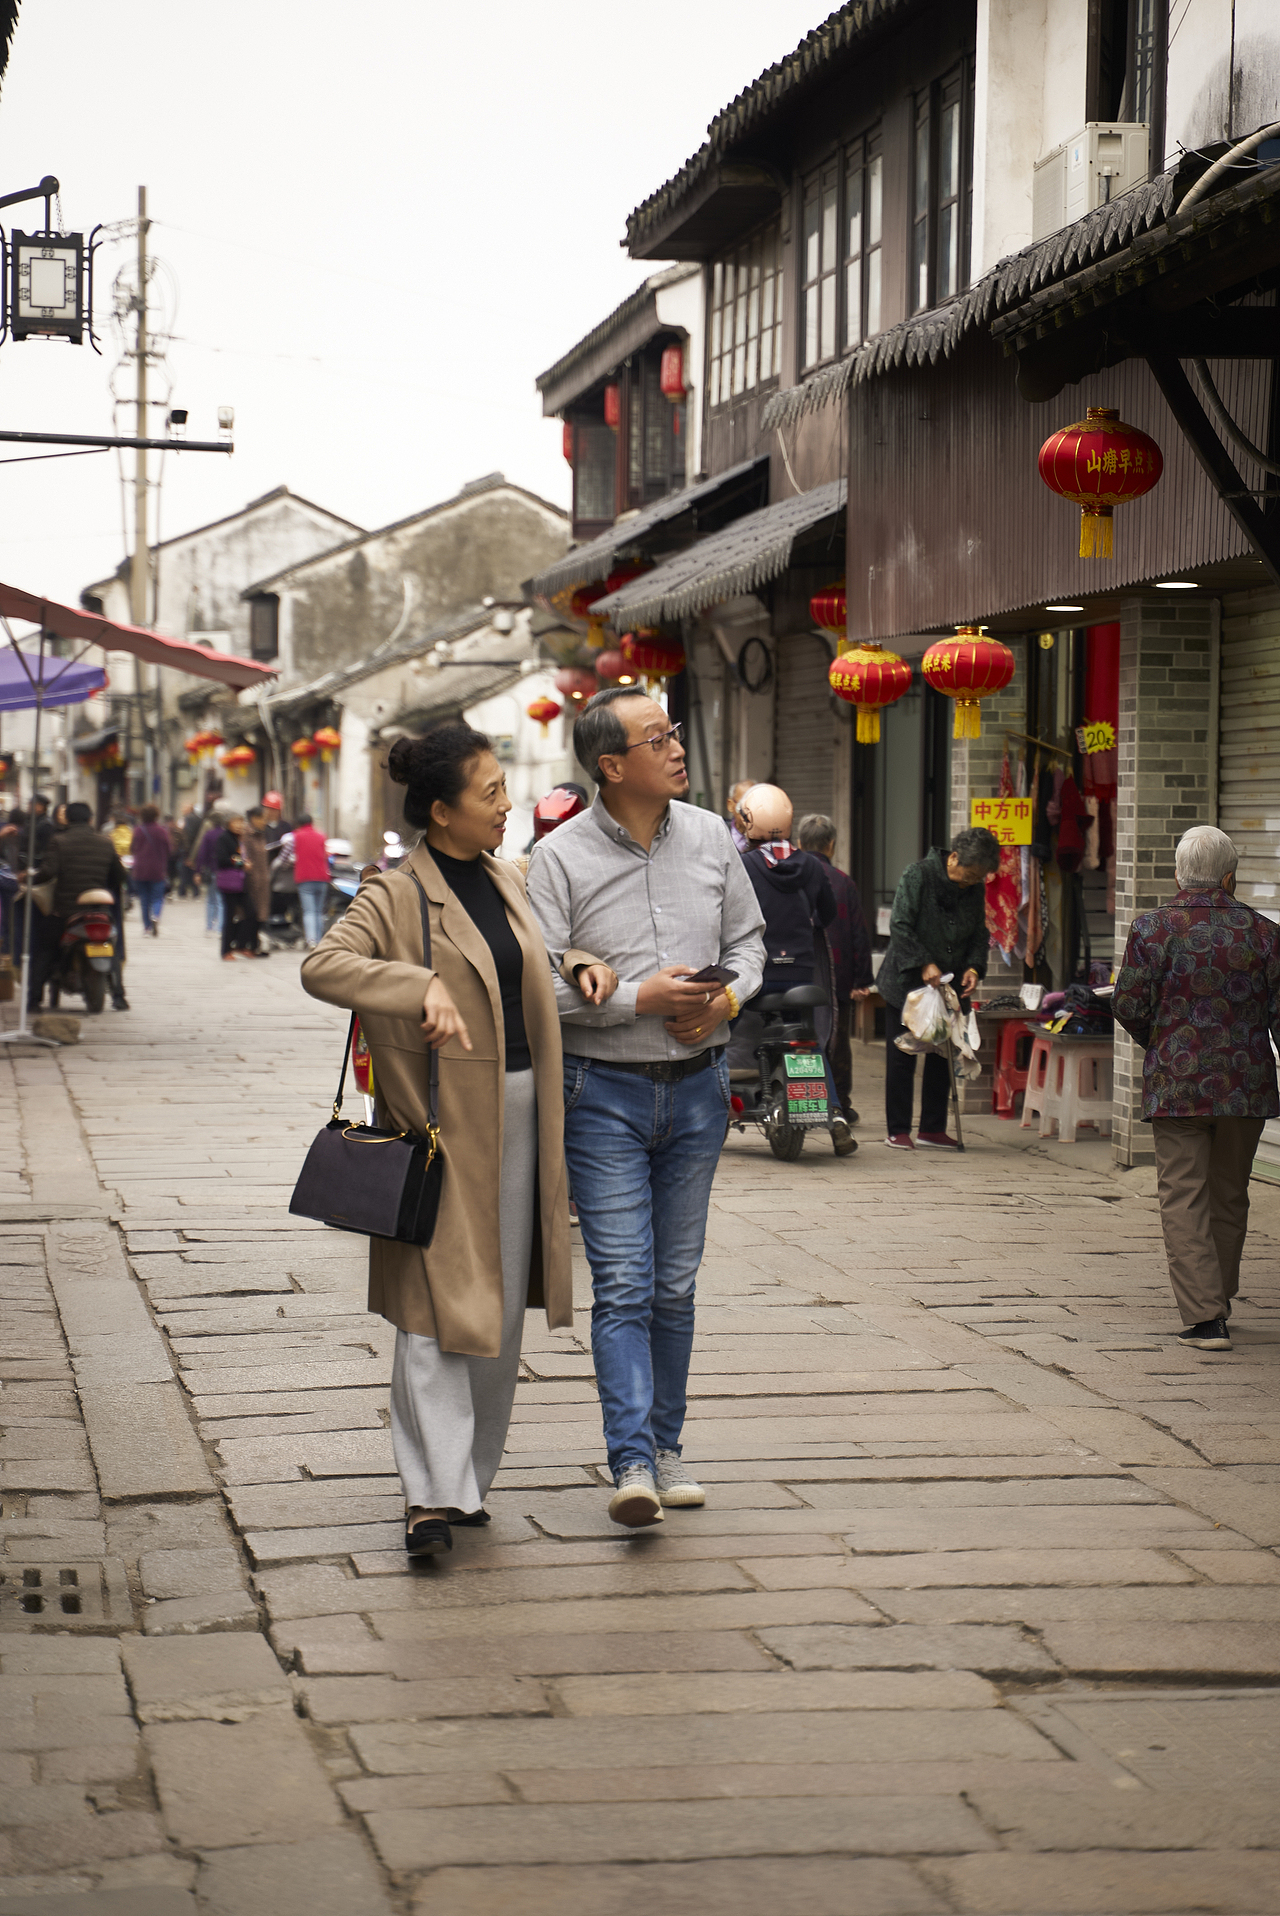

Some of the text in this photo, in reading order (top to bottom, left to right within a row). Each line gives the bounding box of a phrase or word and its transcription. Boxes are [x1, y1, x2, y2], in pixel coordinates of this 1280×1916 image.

[975, 801, 1029, 820] 中方巾
[988, 825, 1015, 843] 5元
